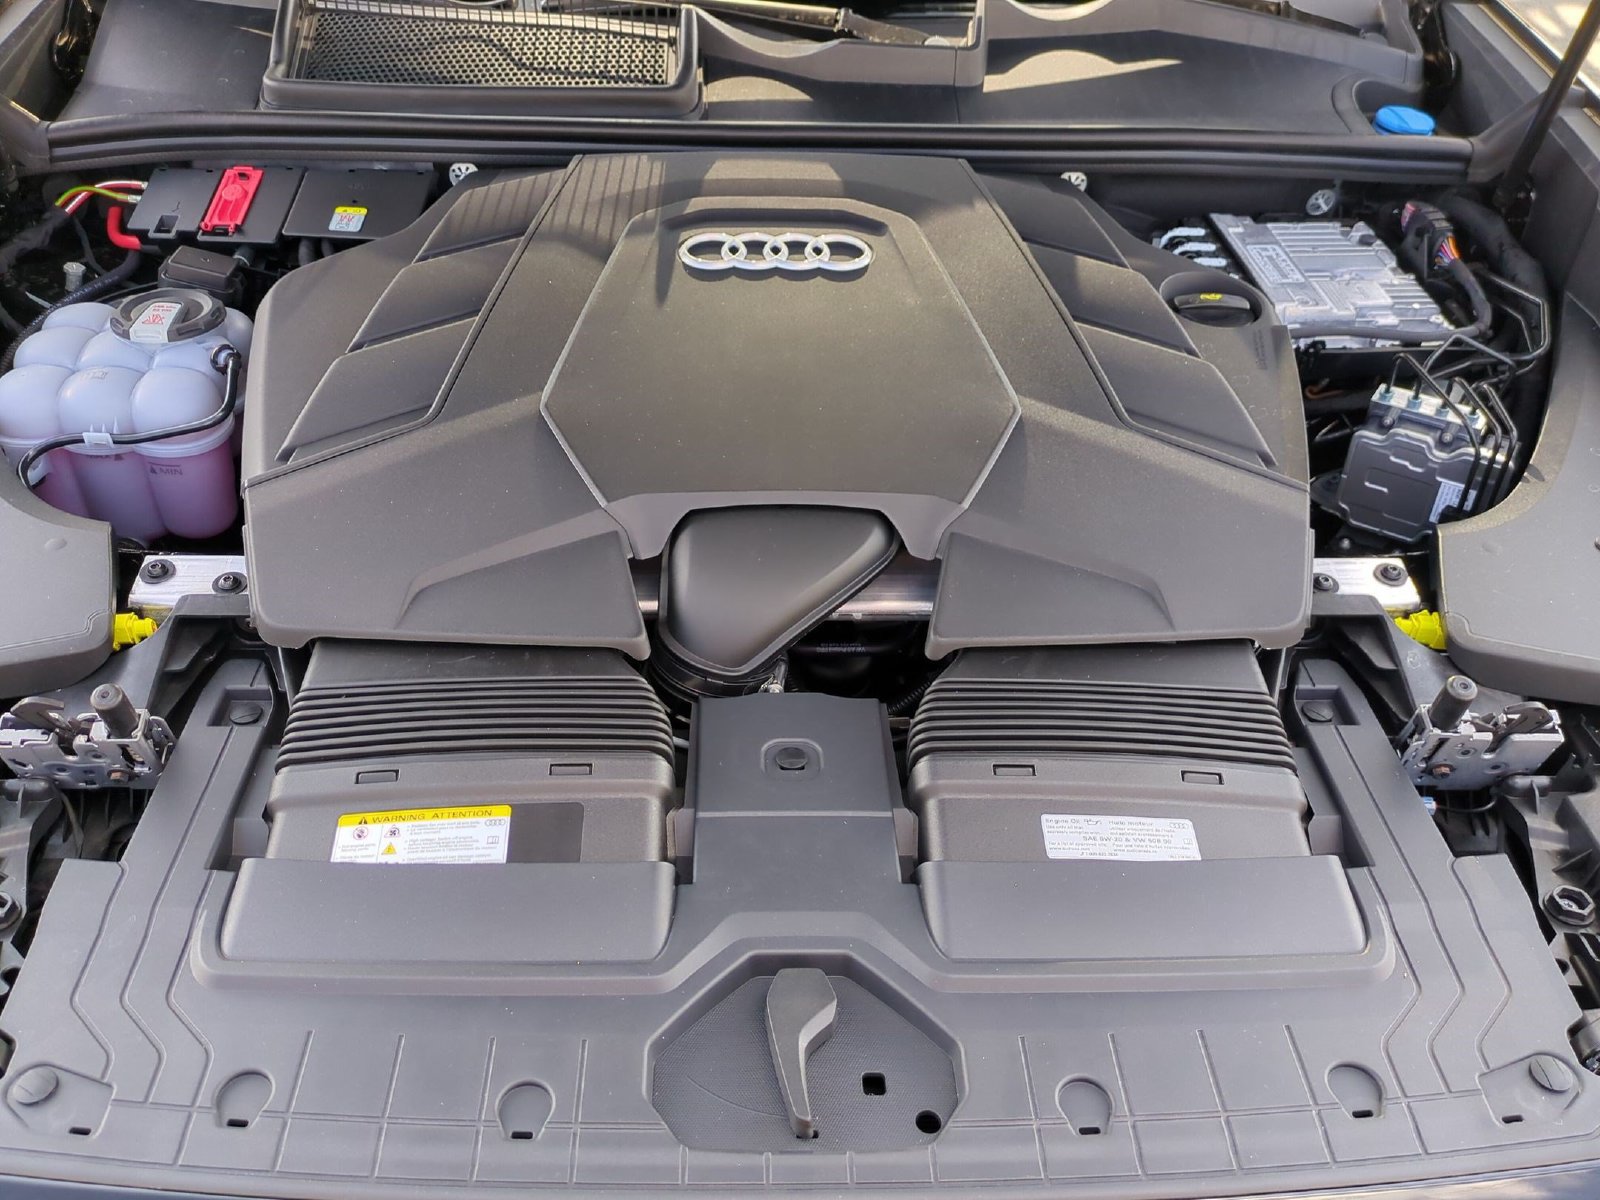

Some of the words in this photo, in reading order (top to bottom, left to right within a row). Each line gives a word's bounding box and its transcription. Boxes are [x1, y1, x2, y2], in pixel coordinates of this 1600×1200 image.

[159, 467, 183, 476] MIN
[372, 813, 425, 824] WARNING
[431, 809, 493, 820] ATTENTION
